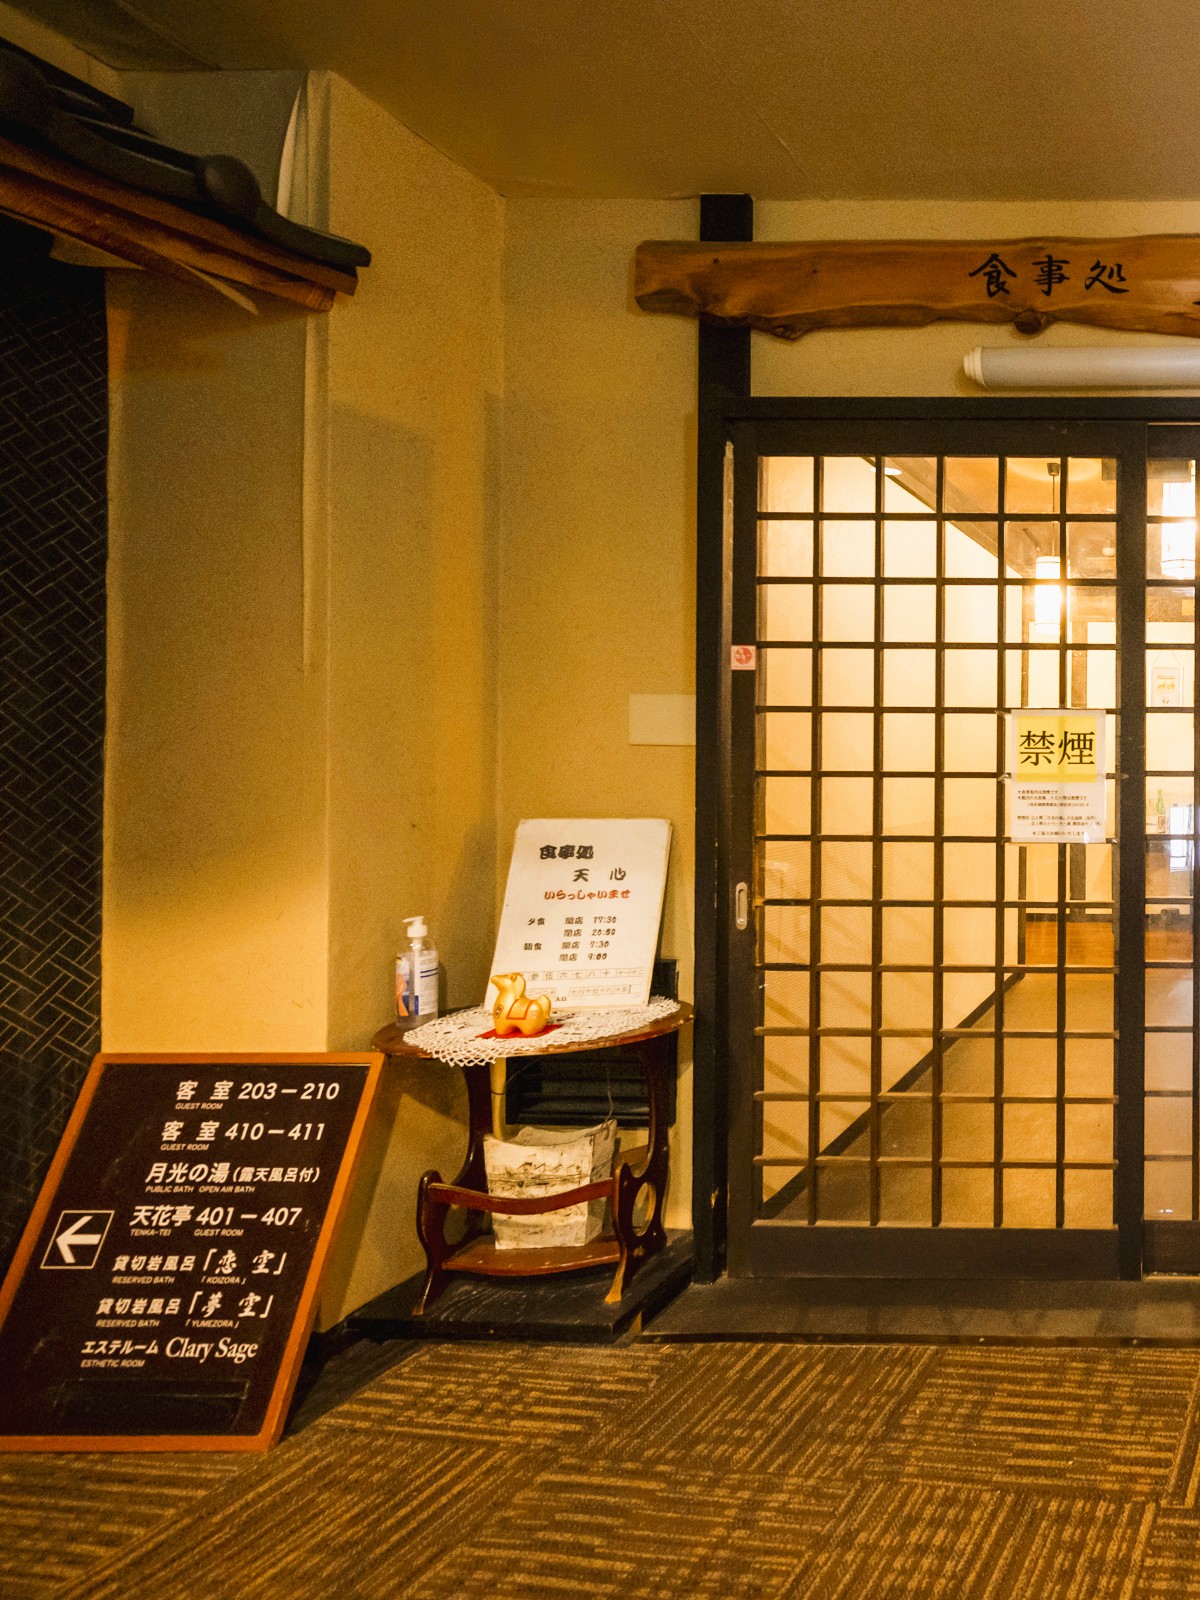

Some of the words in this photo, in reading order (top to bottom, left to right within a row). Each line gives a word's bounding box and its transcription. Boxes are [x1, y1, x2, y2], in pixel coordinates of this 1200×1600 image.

[968, 252, 1130, 298] 食事処
[1019, 730, 1096, 766] 禁煙
[540, 845, 594, 859] 食事処
[544, 889, 631, 900] いらっしゃいませ
[129, 1205, 195, 1227] 天花亭
[96, 1319, 137, 1327] RESERVED
[81, 1340, 159, 1355] エステルーム
[165, 1337, 214, 1363] Clary
[215, 1337, 259, 1364] Sage
[81, 1359, 119, 1368] ESTHETIC
